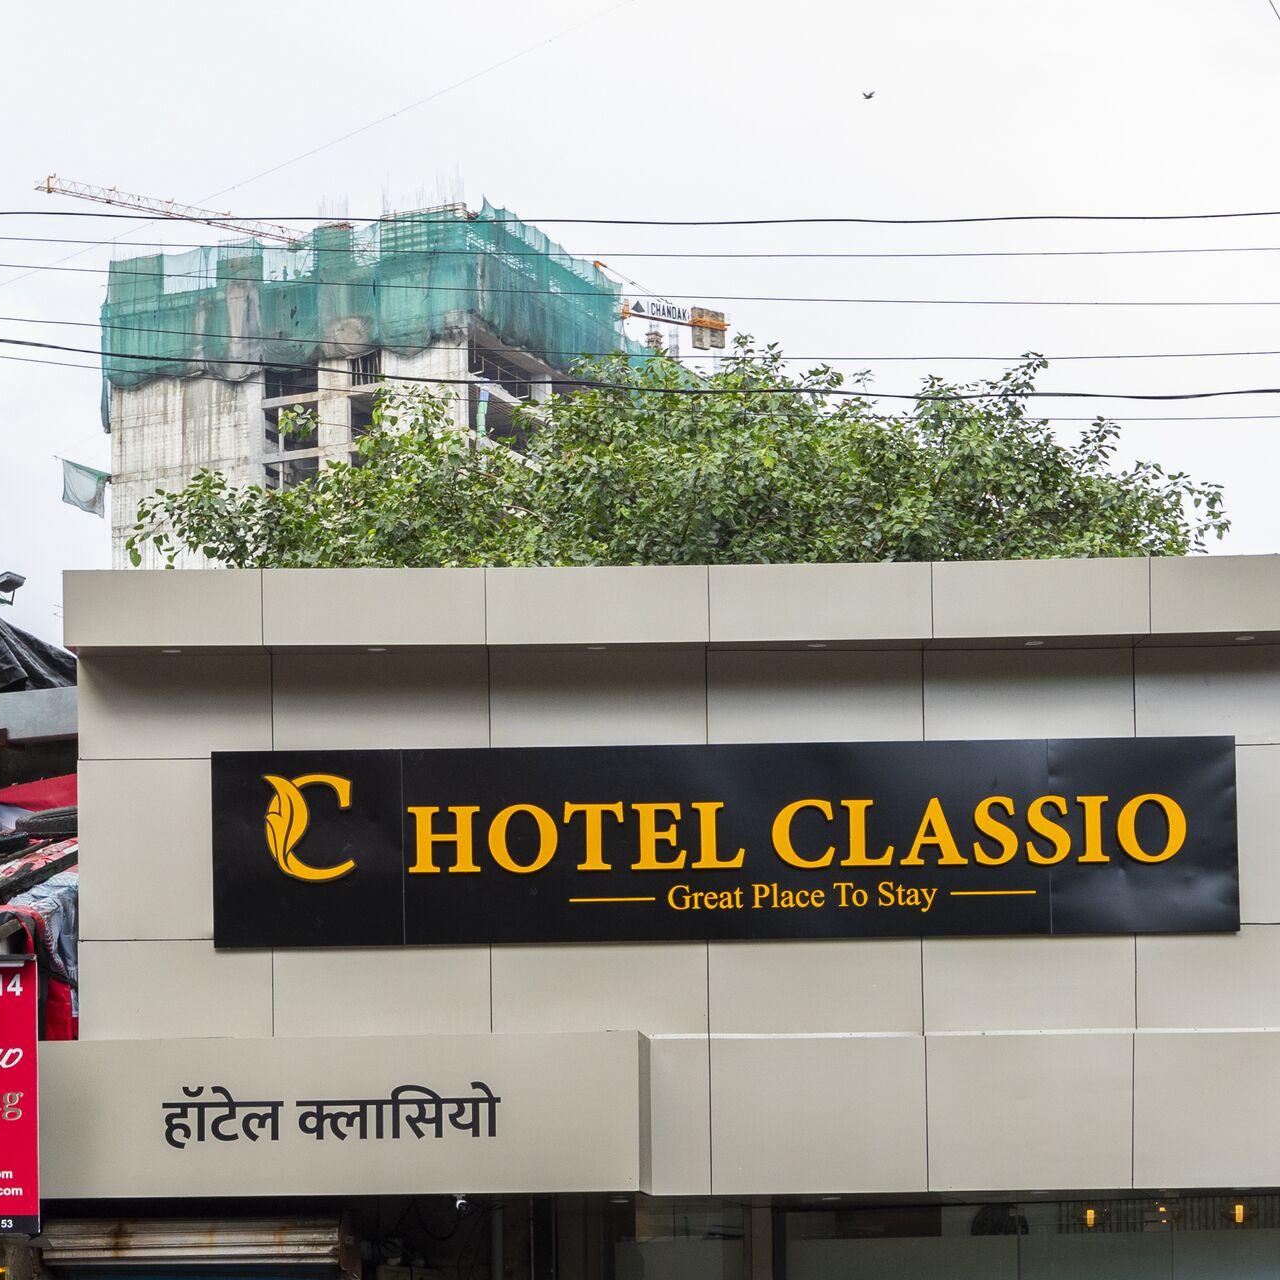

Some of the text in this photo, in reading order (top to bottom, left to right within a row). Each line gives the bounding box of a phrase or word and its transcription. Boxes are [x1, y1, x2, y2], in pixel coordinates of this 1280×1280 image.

[651, 302, 687, 321] CHANDAK
[407, 793, 1187, 874] HOTEL CLASSIO
[668, 881, 938, 913] Great Place To Stay
[162, 1081, 501, 1149] हॉटेल क्लासियो
[1, 1219, 13, 1228] 53
